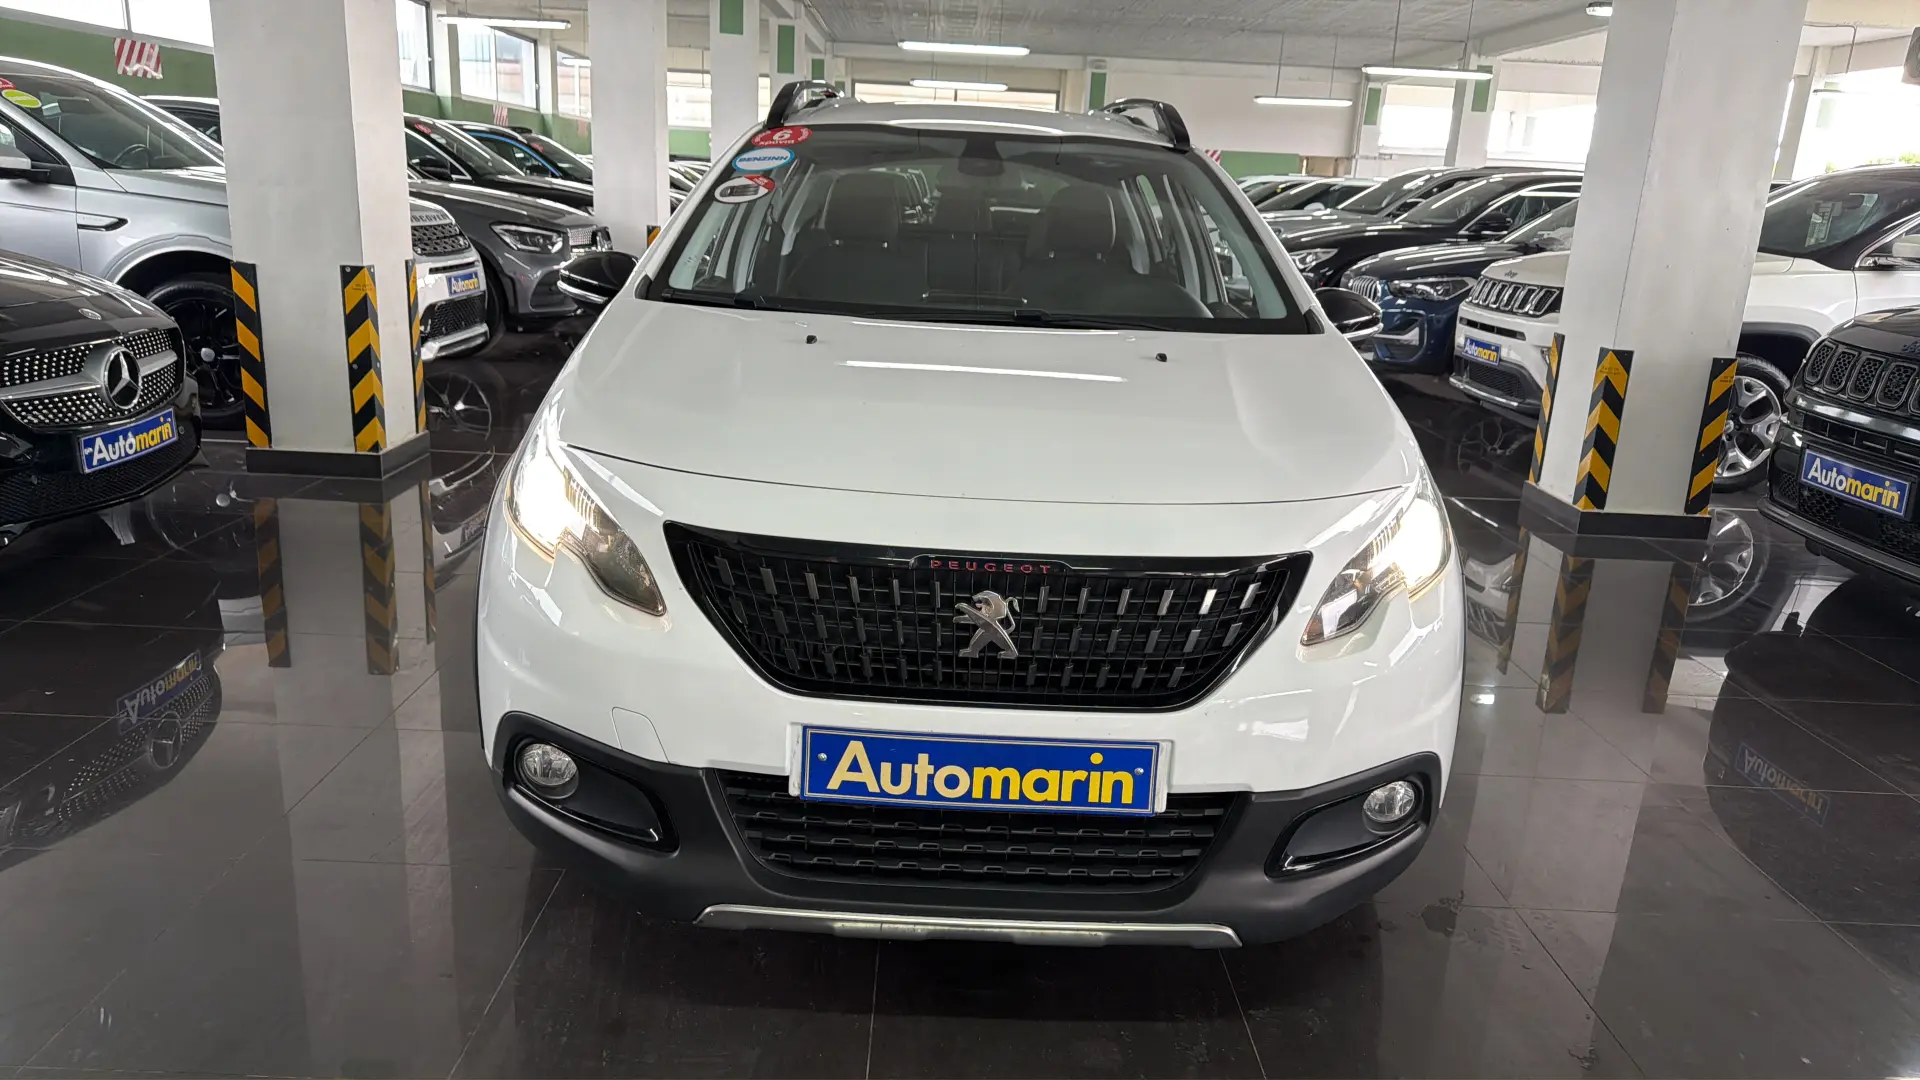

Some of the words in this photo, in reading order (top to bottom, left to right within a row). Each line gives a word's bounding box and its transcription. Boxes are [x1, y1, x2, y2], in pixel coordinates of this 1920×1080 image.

[772, 129, 793, 141] 6
[1464, 339, 1497, 362] Automarin
[93, 416, 172, 466] Automarin
[1807, 457, 1900, 510] Automarin
[930, 559, 1050, 574] PEUGEOT
[826, 740, 1134, 804] Automarin
